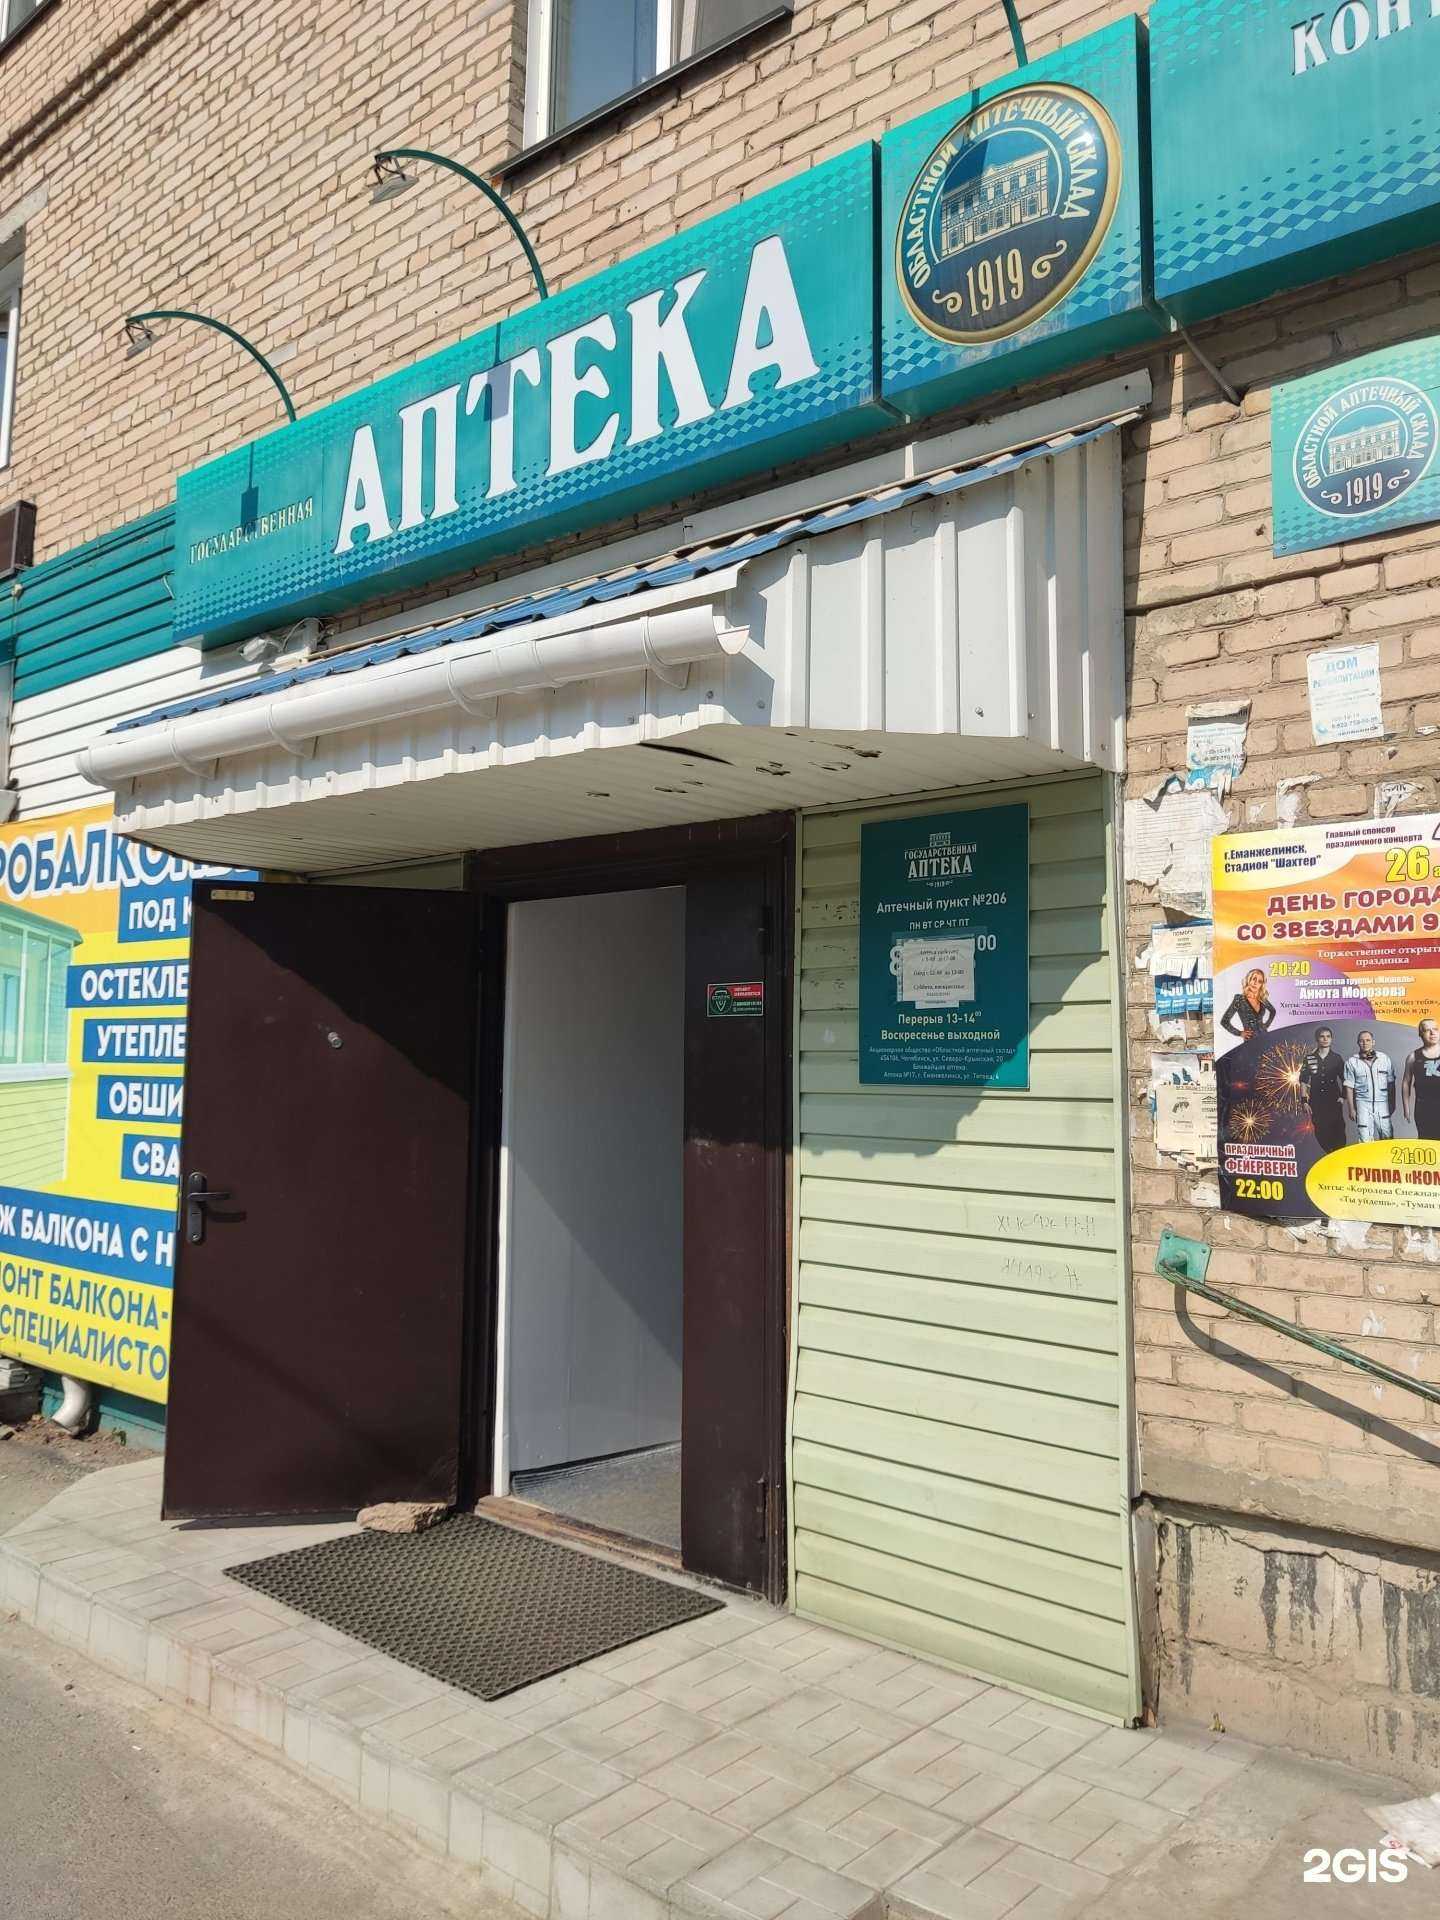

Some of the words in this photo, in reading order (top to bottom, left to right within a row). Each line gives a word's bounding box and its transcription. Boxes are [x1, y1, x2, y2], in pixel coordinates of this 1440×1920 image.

[1292, 0, 1440, 76] КОН
[1060, 130, 1099, 220] СКЛАД
[965, 248, 1024, 318] 1919
[333, 234, 822, 556] АПТЕКА
[1302, 402, 1339, 489] ОБЛАСТНОЙ
[1340, 384, 1421, 415] АПТЕЧНЫЙ
[1409, 411, 1429, 460] СКЛАД
[1346, 472, 1383, 507] 1919
[190, 496, 314, 565] ГОСУДАРСТВЕННАЯ
[1325, 829, 1361, 840] Главный
[1362, 825, 1396, 836] спонсор
[1325, 837, 1383, 850] праздничного
[1384, 834, 1423, 846] концерта
[904, 843, 977, 861] ГОСУДАРСТВЕННАЯ
[908, 854, 973, 879] АПТЕКА
[1224, 860, 1269, 874] Стадион
[1271, 854, 1322, 870] "Шахтер"
[1385, 846, 1430, 882] 26
[876, 898, 933, 915] Аптечный
[936, 897, 970, 912] пункт
[972, 891, 1007, 907] №206
[1266, 893, 1336, 917] ДЕНЬ
[128, 901, 176, 933] ПОД
[909, 921, 921, 931] ПН
[922, 920, 933, 930] ВТ
[934, 919, 945, 929] СР
[945, 918, 958, 928] ЧТ
[958, 917, 970, 927] ПТ
[1236, 923, 1267, 942] СО
[1273, 913, 1414, 939] ЗВЕЗДАМИ
[977, 934, 997, 951] 00
[1269, 960, 1311, 977] 20:20
[1355, 958, 1410, 968] праздника
[1299, 986, 1340, 1000] Анюта
[1342, 985, 1406, 1000] Морозова
[898, 1013, 943, 1026] Перерыв
[881, 1029, 945, 1043] Воскресенье
[947, 1028, 1000, 1041] выходной
[1225, 1143, 1295, 1158] ПРАЗДНИЧНЫЙ
[1391, 1147, 1437, 1166] 21:00
[1225, 1158, 1297, 1176] ФЕЙЕРВЕРК
[1348, 1166, 1402, 1183] ГРУППА
[1235, 1178, 1284, 1201] 22:00
[20, 1208, 125, 1259] БАЛКОНА
[130, 1227, 149, 1263] С
[0, 1260, 44, 1300] ОНТ
[0, 1303, 168, 1382] СПЕЦИАЛИСТО
